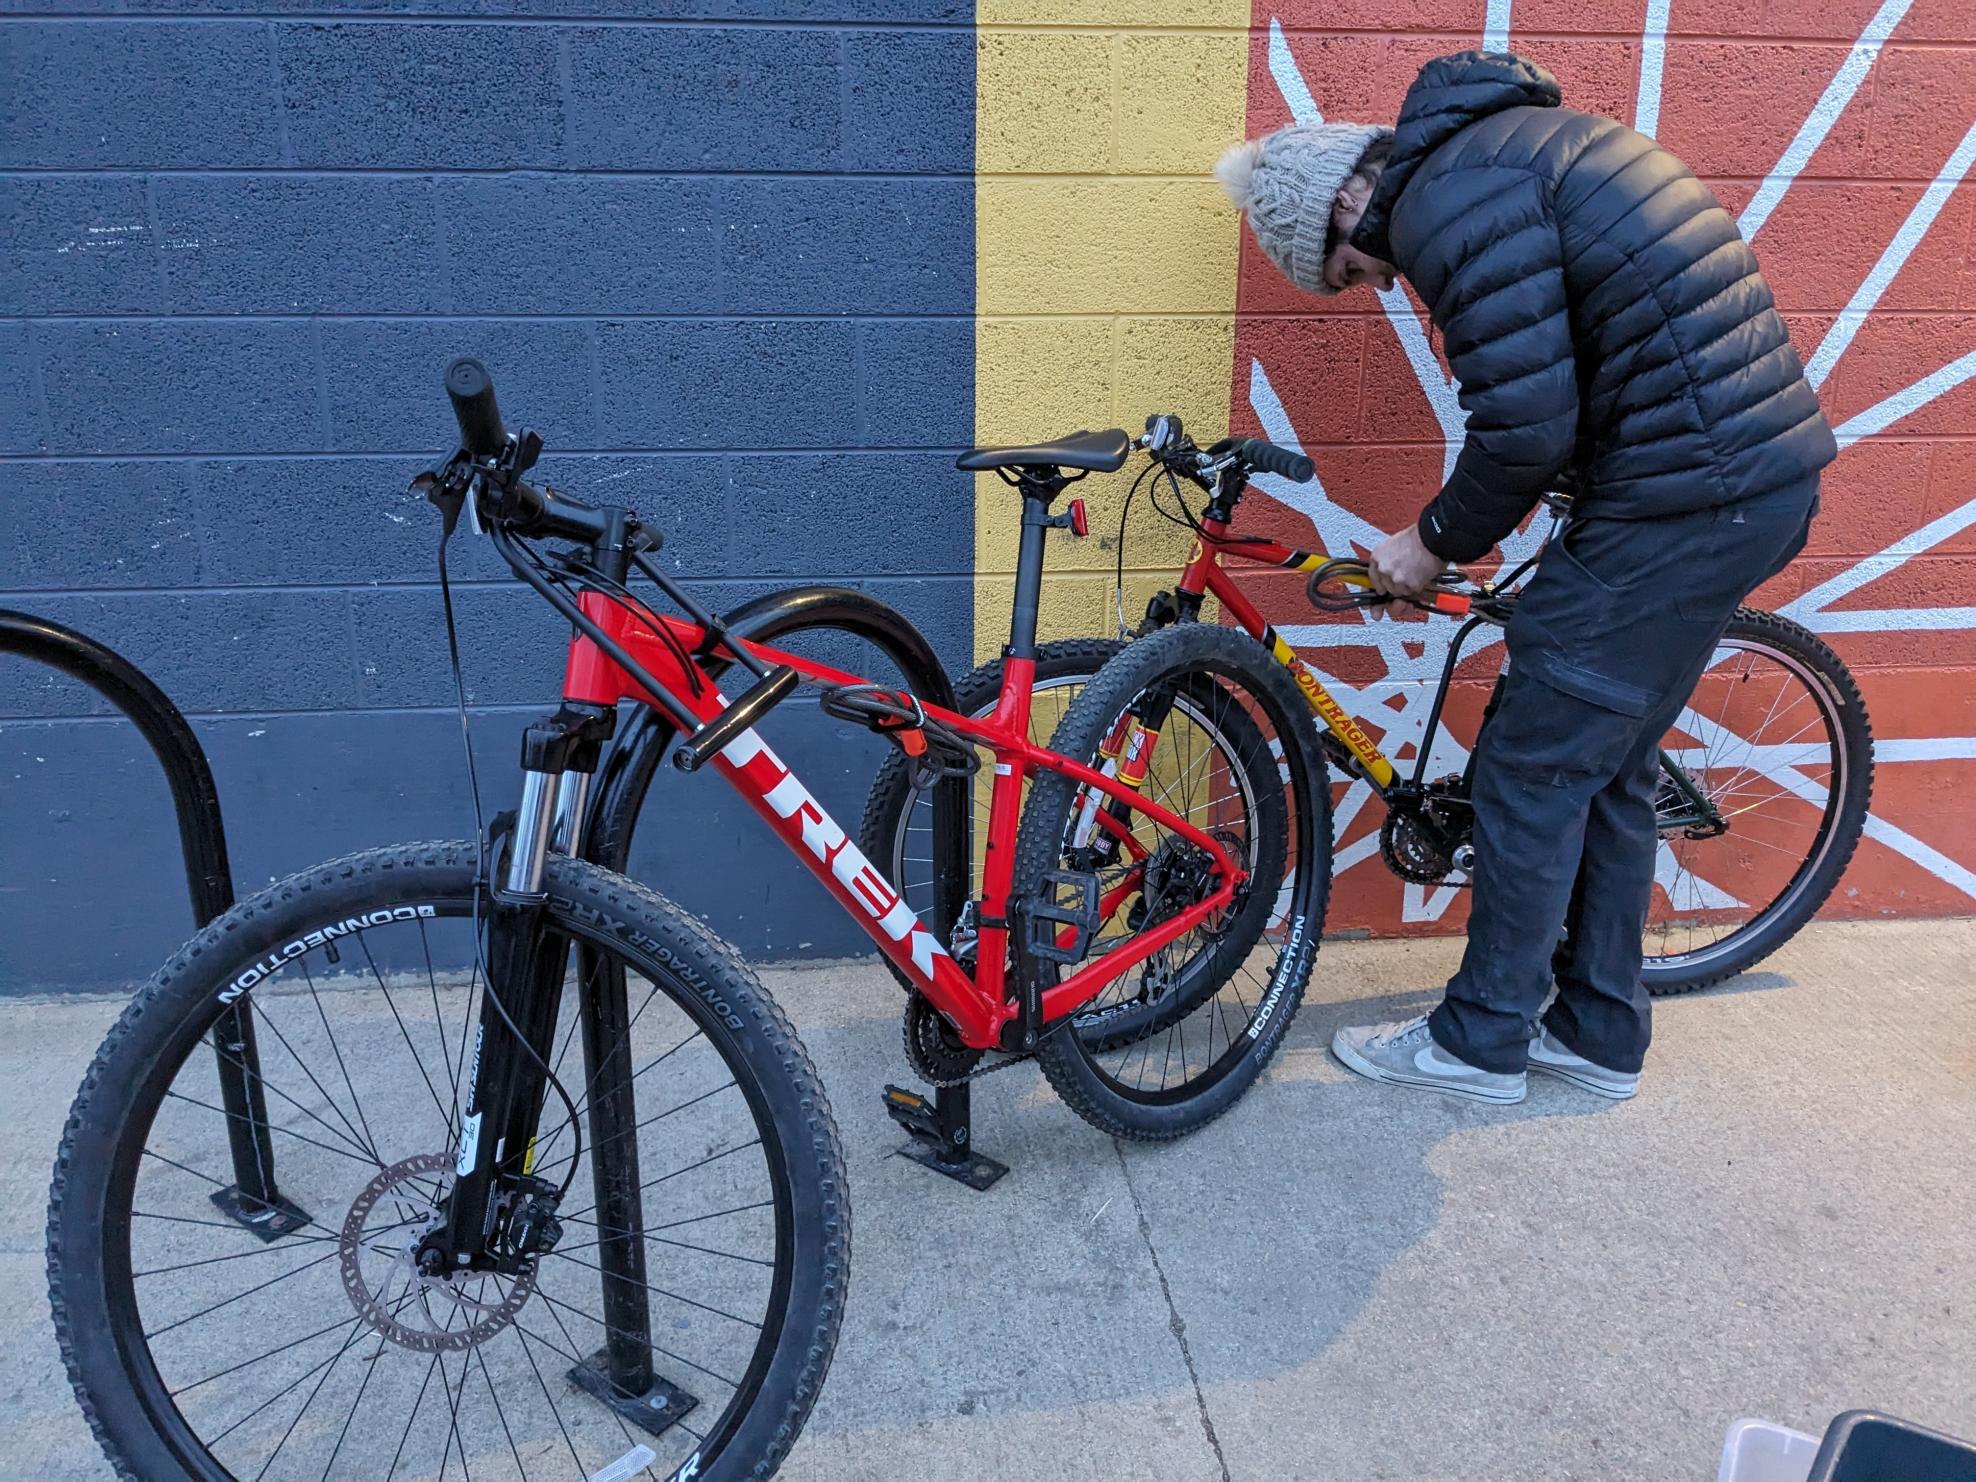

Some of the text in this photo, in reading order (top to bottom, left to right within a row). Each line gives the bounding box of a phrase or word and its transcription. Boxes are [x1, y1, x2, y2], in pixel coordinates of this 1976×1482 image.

[716, 693, 949, 982] TREK
[218, 906, 418, 1004] CONNECTION
[627, 930, 745, 1031] BONTRAGER
[1253, 915, 1306, 1032] CONNECTION
